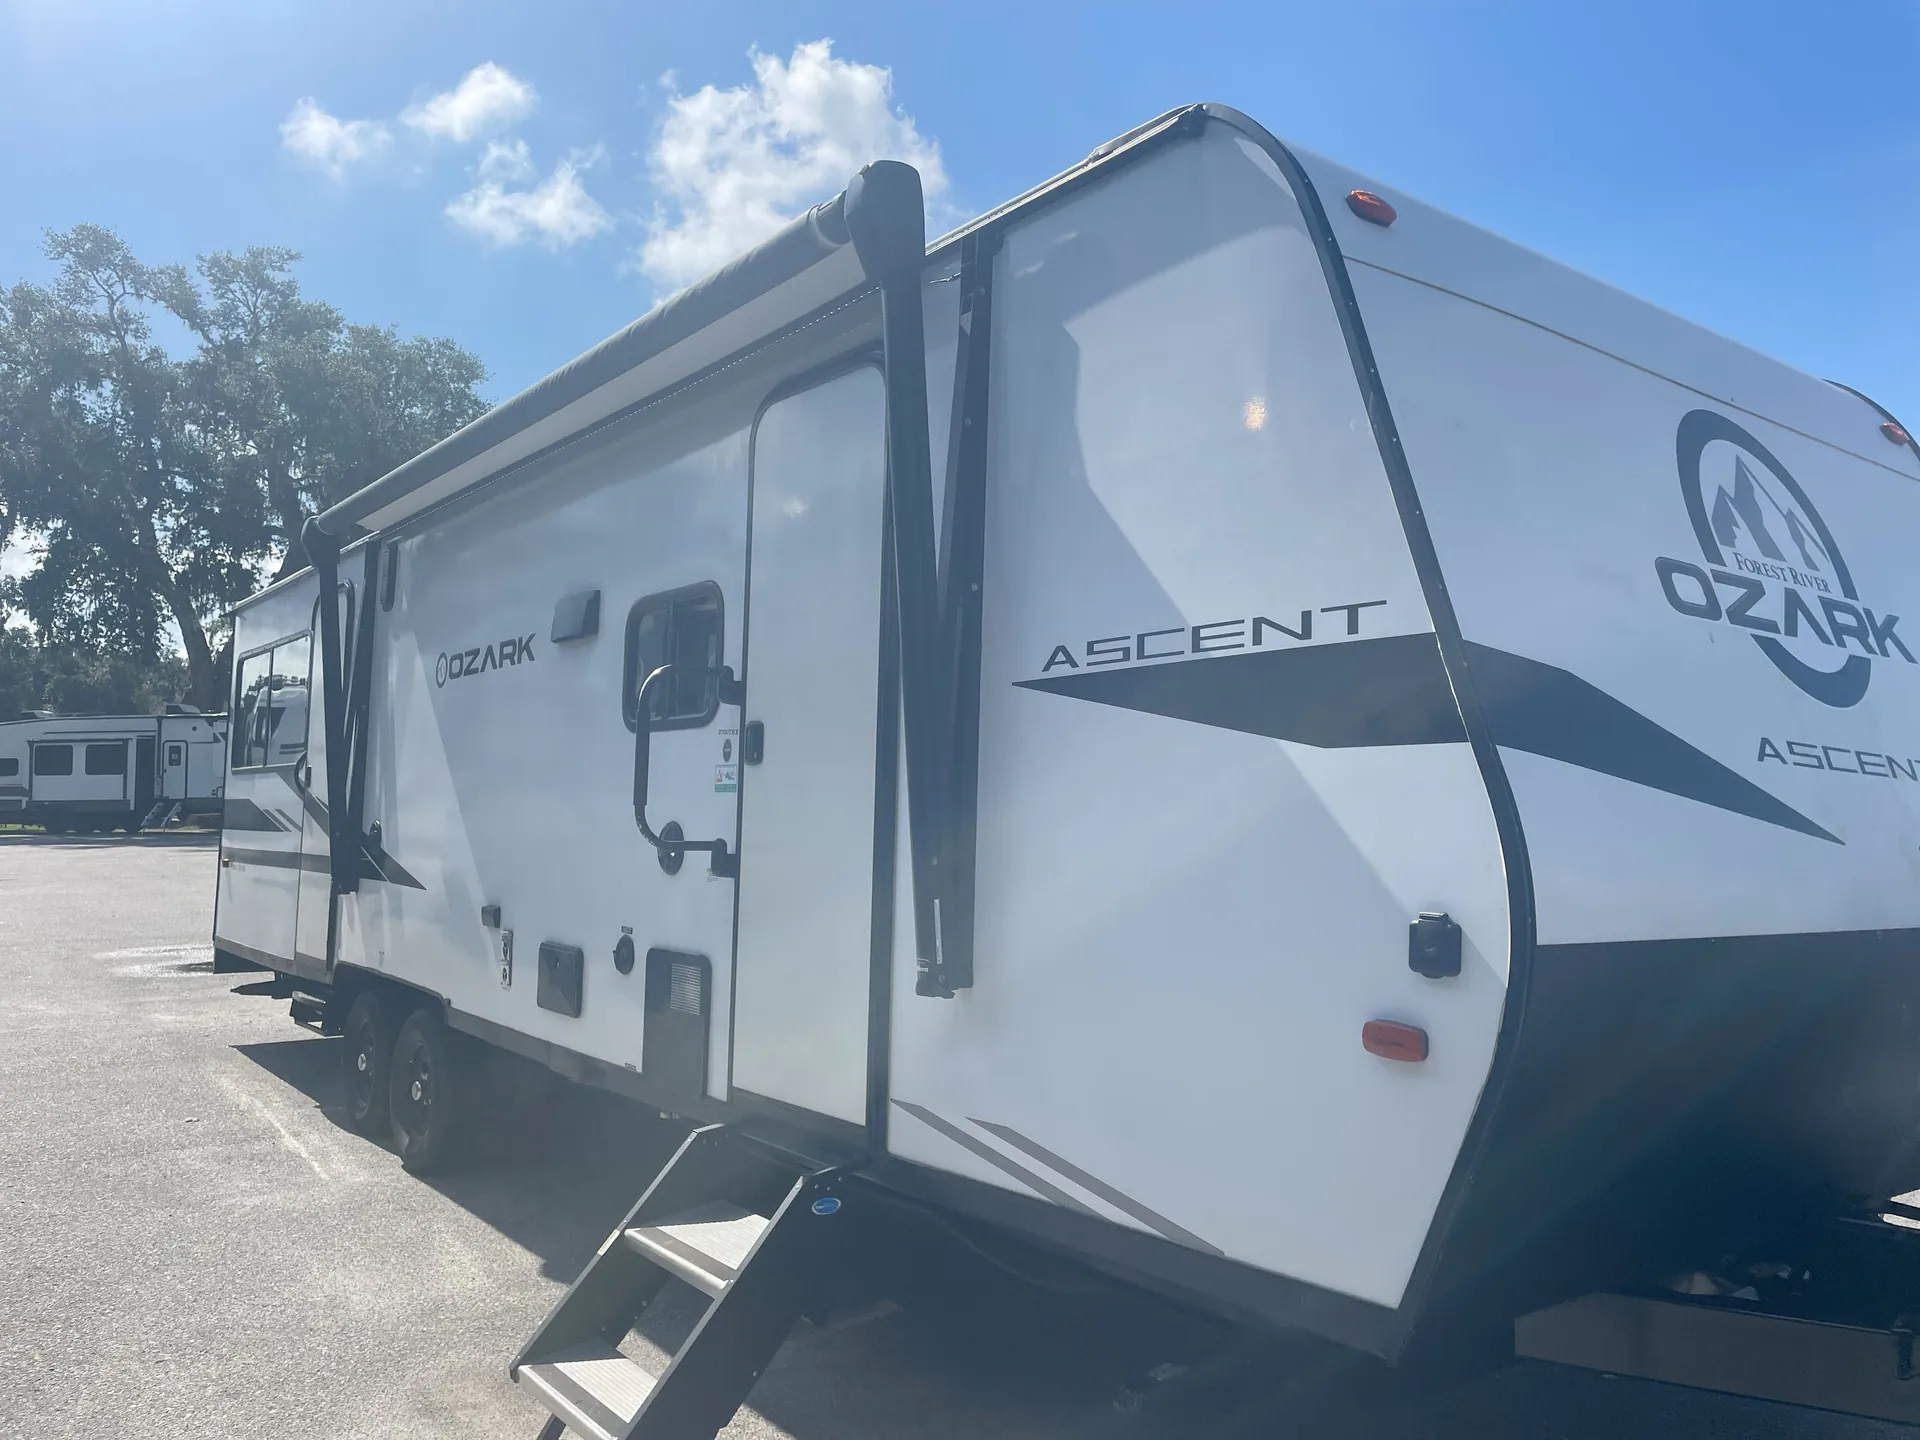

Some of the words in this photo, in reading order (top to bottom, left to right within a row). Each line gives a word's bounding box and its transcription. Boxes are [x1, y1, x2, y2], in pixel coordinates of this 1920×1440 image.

[1732, 551, 1788, 582] FOREST
[1786, 566, 1832, 593] RIVER
[1655, 556, 1918, 664] OZARK
[448, 632, 536, 680] OZARK
[1041, 599, 1387, 672] ASCENT
[1757, 736, 1920, 782] ASCEN
